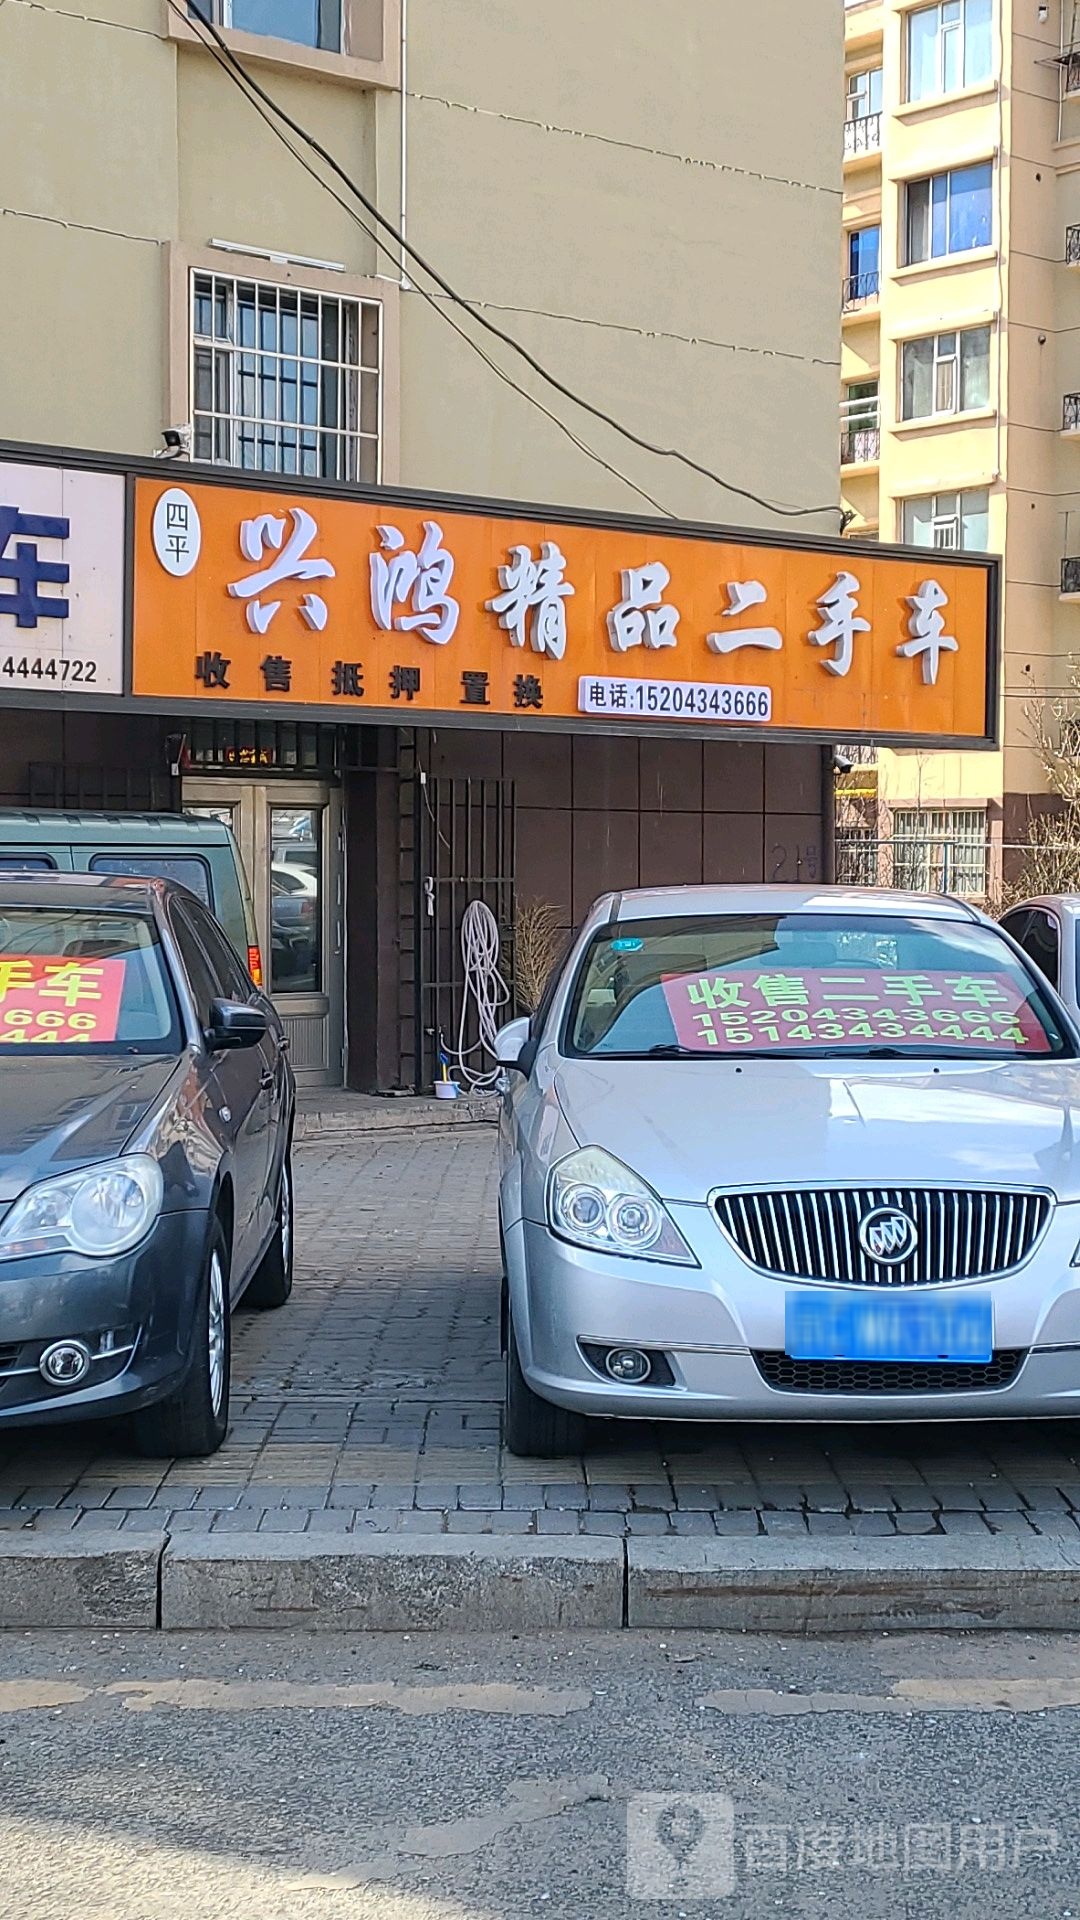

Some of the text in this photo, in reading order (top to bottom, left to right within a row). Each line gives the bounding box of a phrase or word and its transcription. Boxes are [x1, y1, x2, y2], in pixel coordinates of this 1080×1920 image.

[165, 502, 190, 563] 四平
[0, 505, 70, 628] 车
[226, 507, 958, 685] 兴鸿精品二手车
[3, 656, 97, 683] 4444722
[195, 651, 544, 708] 收售抵押置换
[589, 681, 769, 717] 电话:15204343666
[686, 974, 1009, 1009] 收售二手车
[3, 1008, 97, 1030] 666
[693, 1008, 1021, 1027] 15204343666
[697, 1023, 1029, 1045] 15143434444
